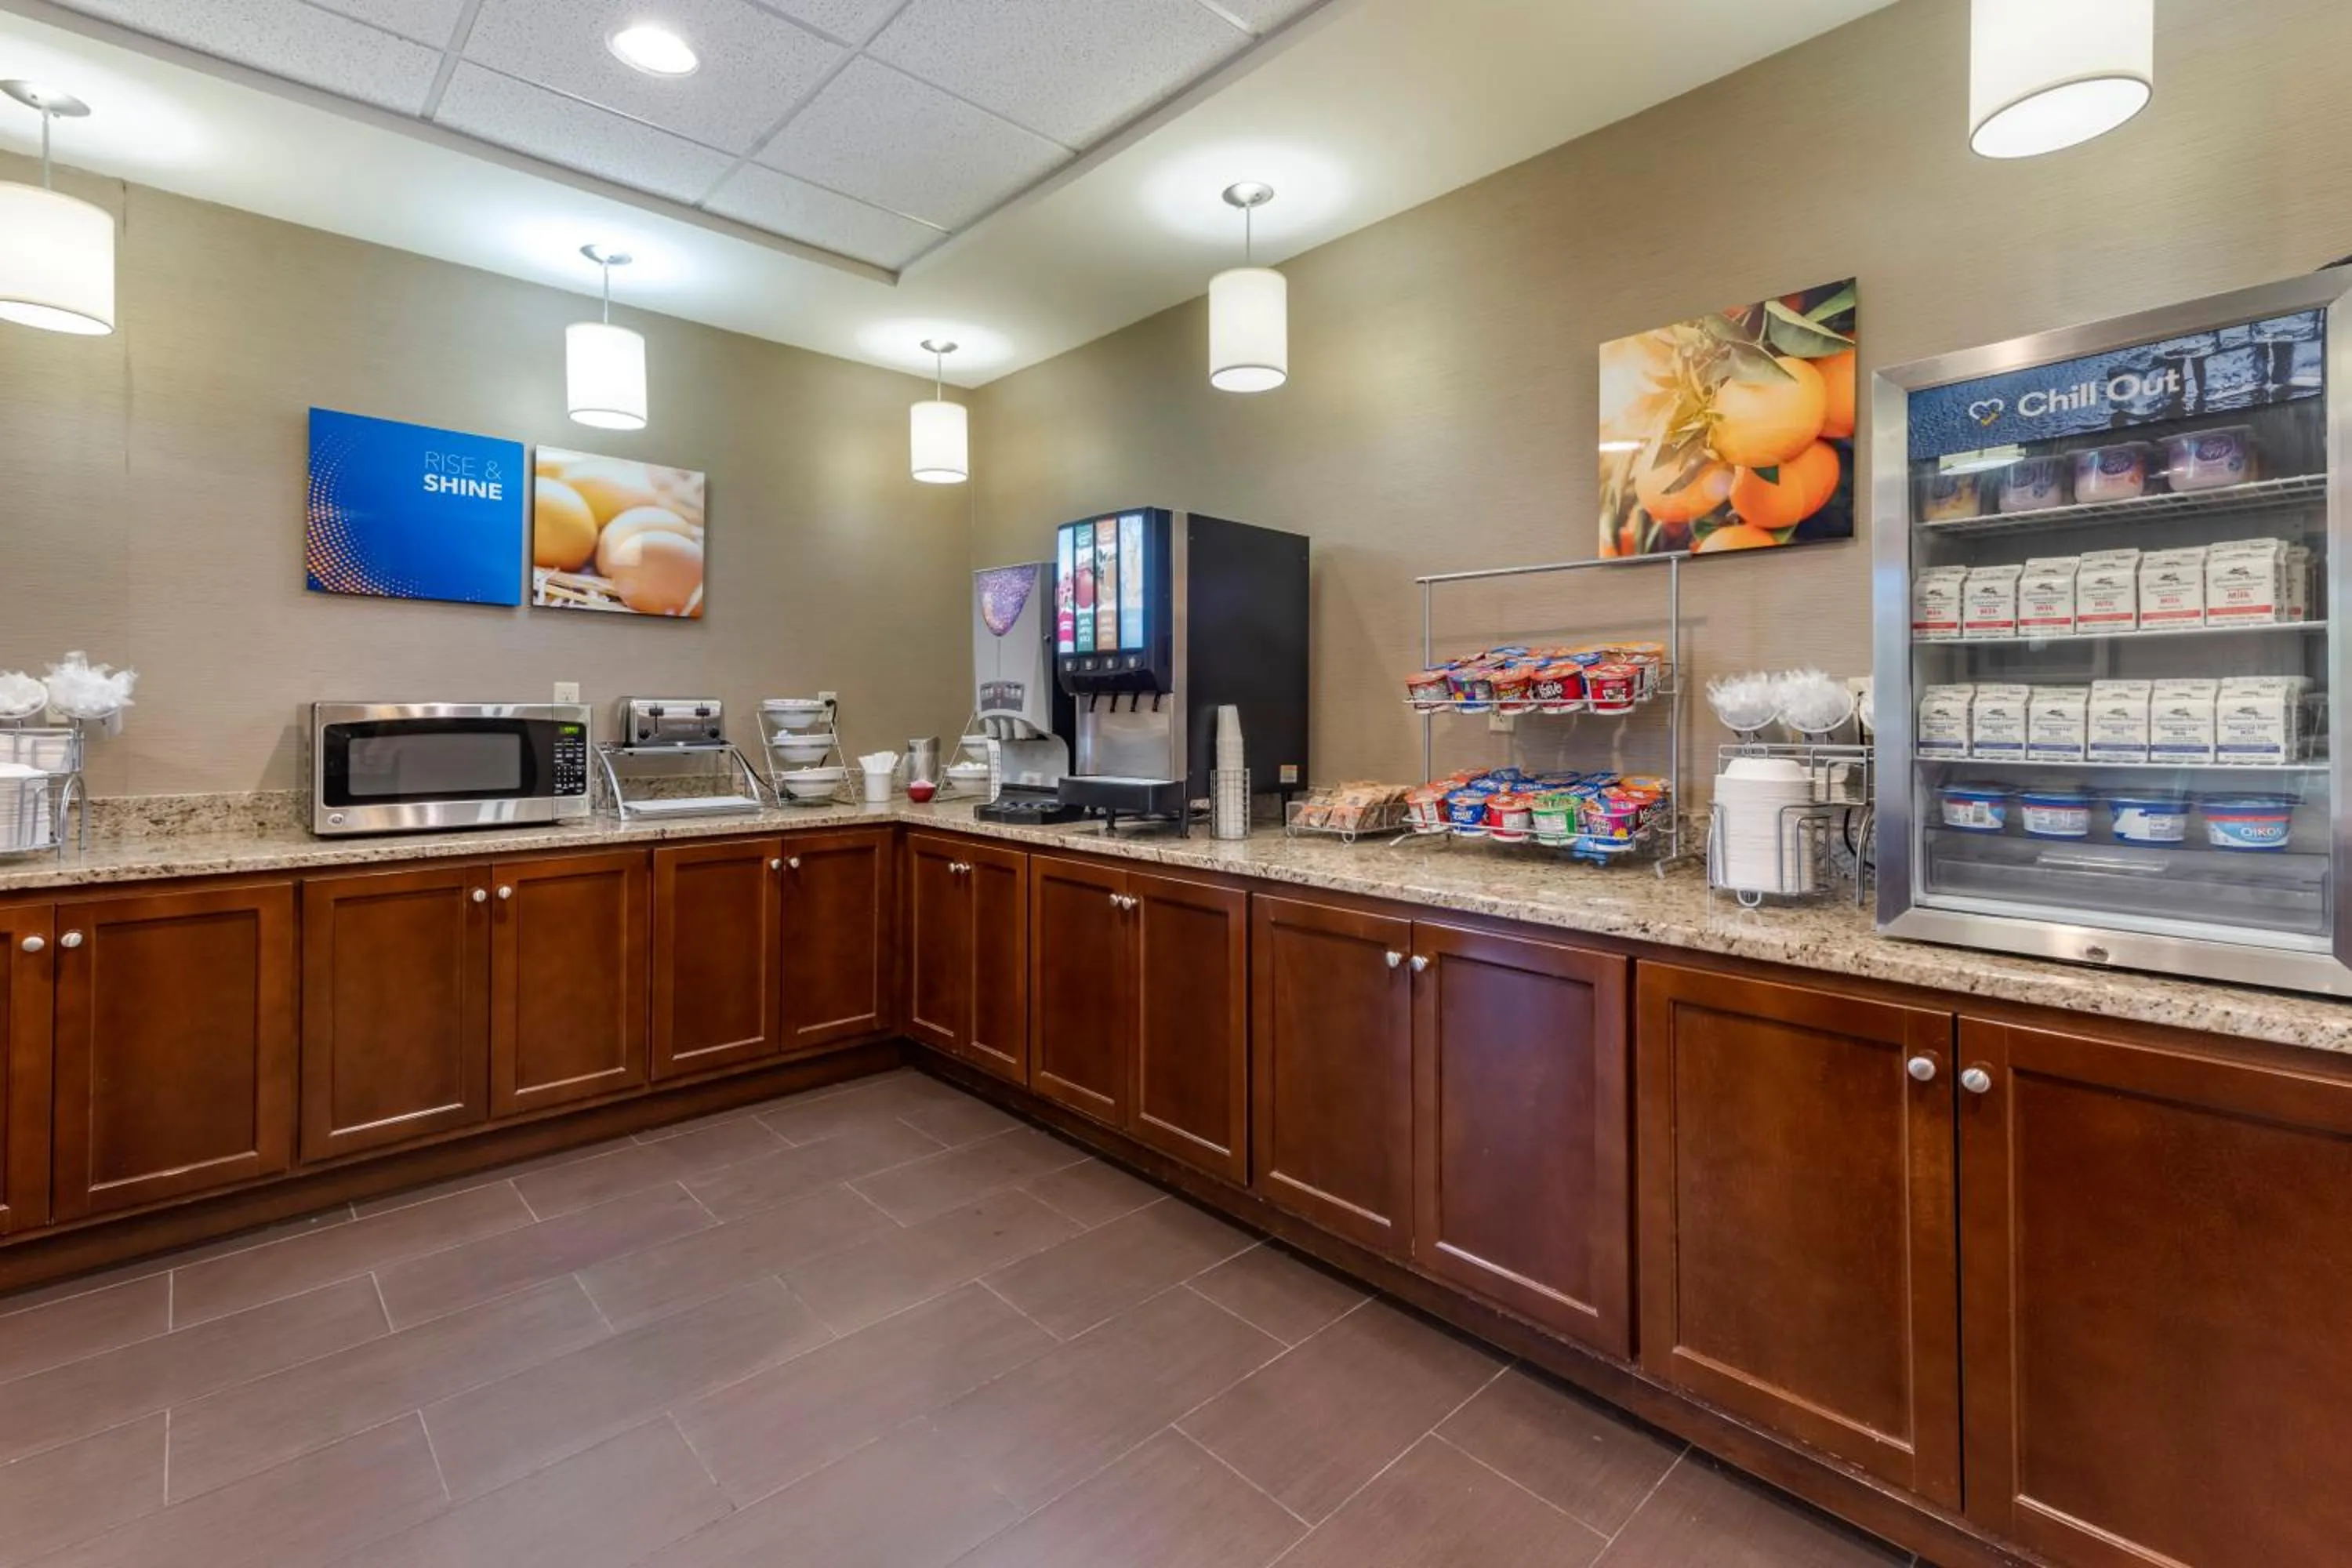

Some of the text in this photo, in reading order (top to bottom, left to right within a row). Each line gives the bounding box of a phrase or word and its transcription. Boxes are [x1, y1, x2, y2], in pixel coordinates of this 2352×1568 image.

[2017, 368, 2180, 417] Chill Out
[424, 451, 503, 480] RISE &
[423, 473, 503, 500] SHINE
